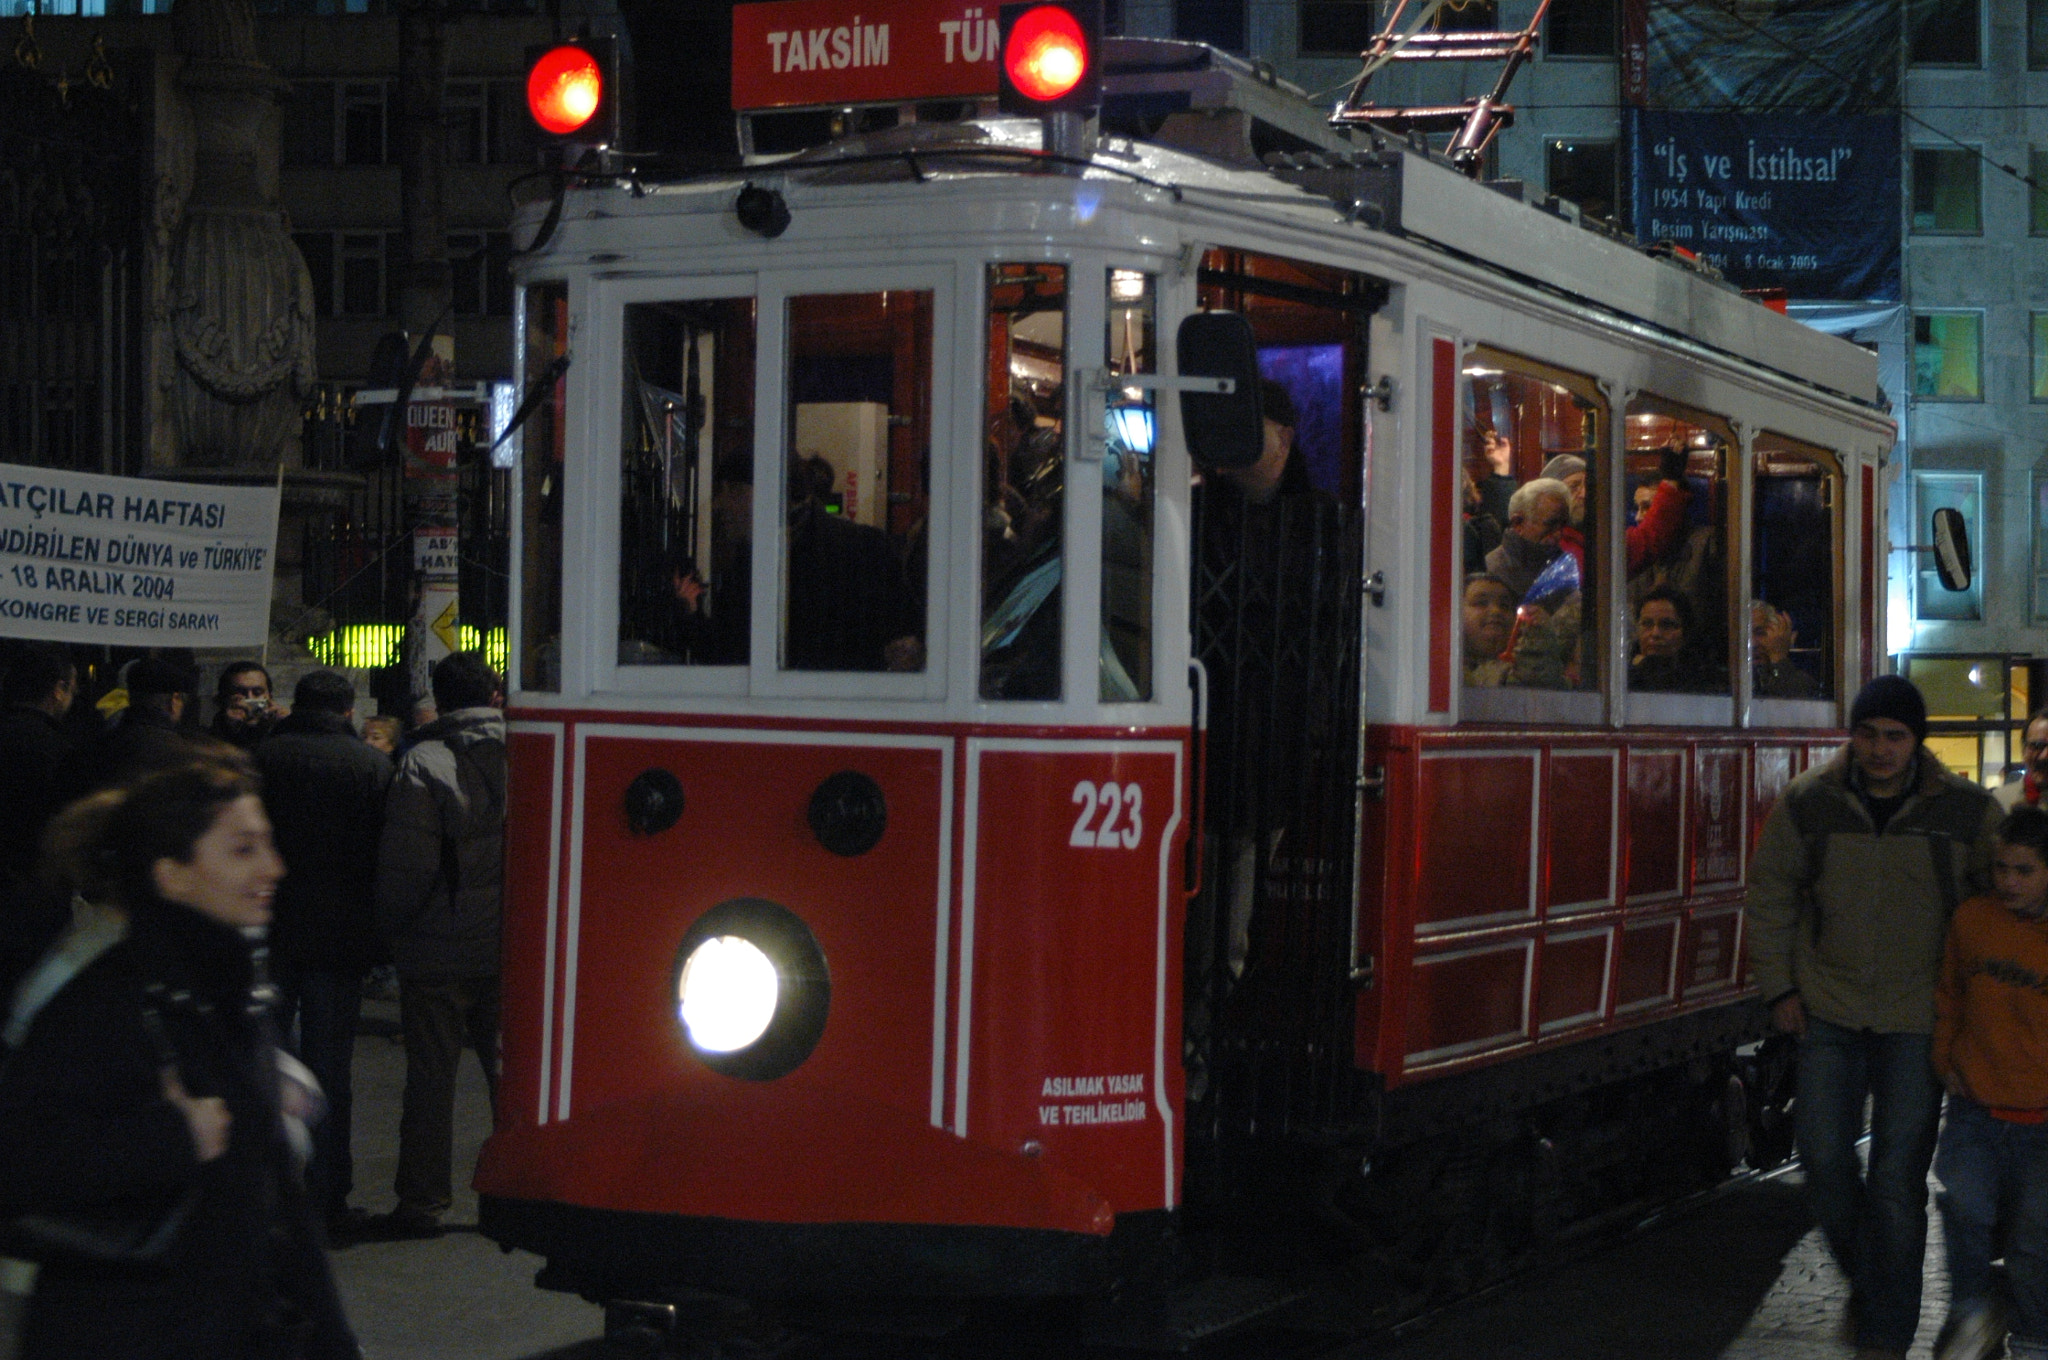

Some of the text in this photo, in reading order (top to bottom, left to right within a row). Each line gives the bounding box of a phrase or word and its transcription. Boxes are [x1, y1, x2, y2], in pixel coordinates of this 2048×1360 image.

[767, 16, 890, 74] TAKSİM
[1704, 154, 1732, 179] ve
[1653, 189, 1773, 214] 1954 Yapı Kredi
[1652, 219, 1693, 239] Resim
[1758, 253, 1784, 270] Ocak
[1790, 254, 1818, 270] 2005
[124, 496, 225, 529] HAFTASI
[106, 534, 173, 568] DÜNYA
[180, 550, 198, 569] ve
[11, 564, 174, 601] 18 ARALIK 2004
[87, 607, 109, 626] VE
[114, 606, 165, 629] SERGİ
[168, 611, 219, 631] SARAYI
[1069, 780, 1143, 850] 223
[1042, 1073, 1144, 1097] ASILMAK YASAK
[1039, 1098, 1146, 1125] VE TEHLİKELİDİR
